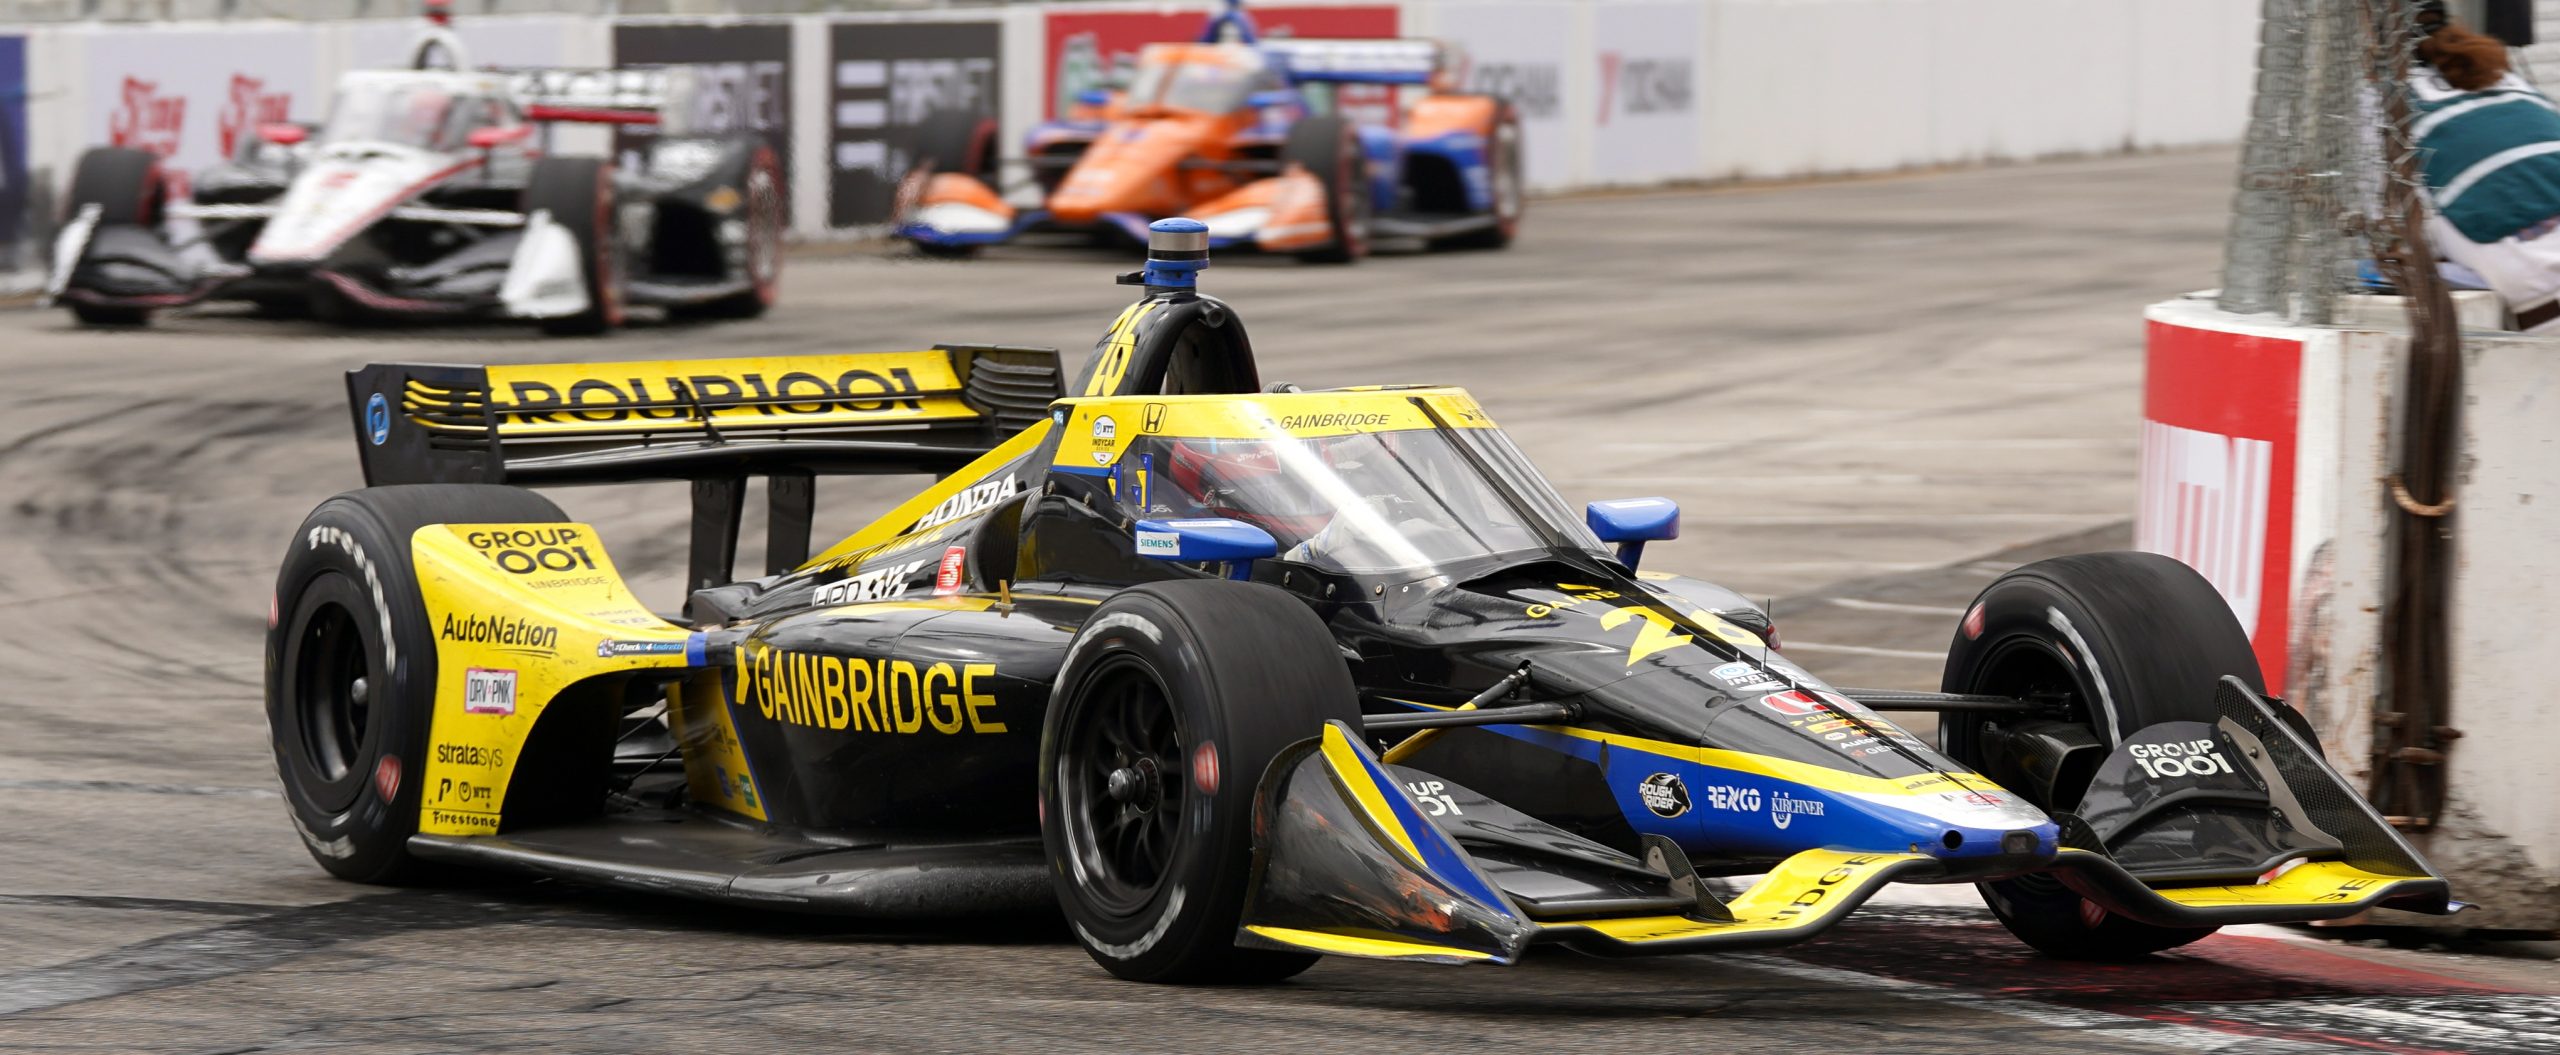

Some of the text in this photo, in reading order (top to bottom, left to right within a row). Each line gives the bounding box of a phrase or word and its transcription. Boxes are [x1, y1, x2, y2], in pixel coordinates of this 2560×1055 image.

[1280, 413, 1391, 430] GAINBRIDGE
[910, 471, 1017, 534] HONDA
[468, 528, 577, 549] GROUP
[1140, 538, 1174, 549] SIEMENS
[441, 612, 557, 649] AutoNation
[755, 645, 1008, 735] GAINBRIDGE
[437, 743, 504, 771] stratasys
[2128, 739, 2215, 758] GROUP
[2135, 752, 2234, 779] 1001
[473, 786, 492, 799] NTT
[1639, 782, 1673, 799] ROUGH
[1707, 785, 1762, 812] REXCO
[1644, 795, 1675, 810] RIDER
[1771, 797, 1825, 816] KIRCHNER
[432, 810, 498, 828] Firestone
